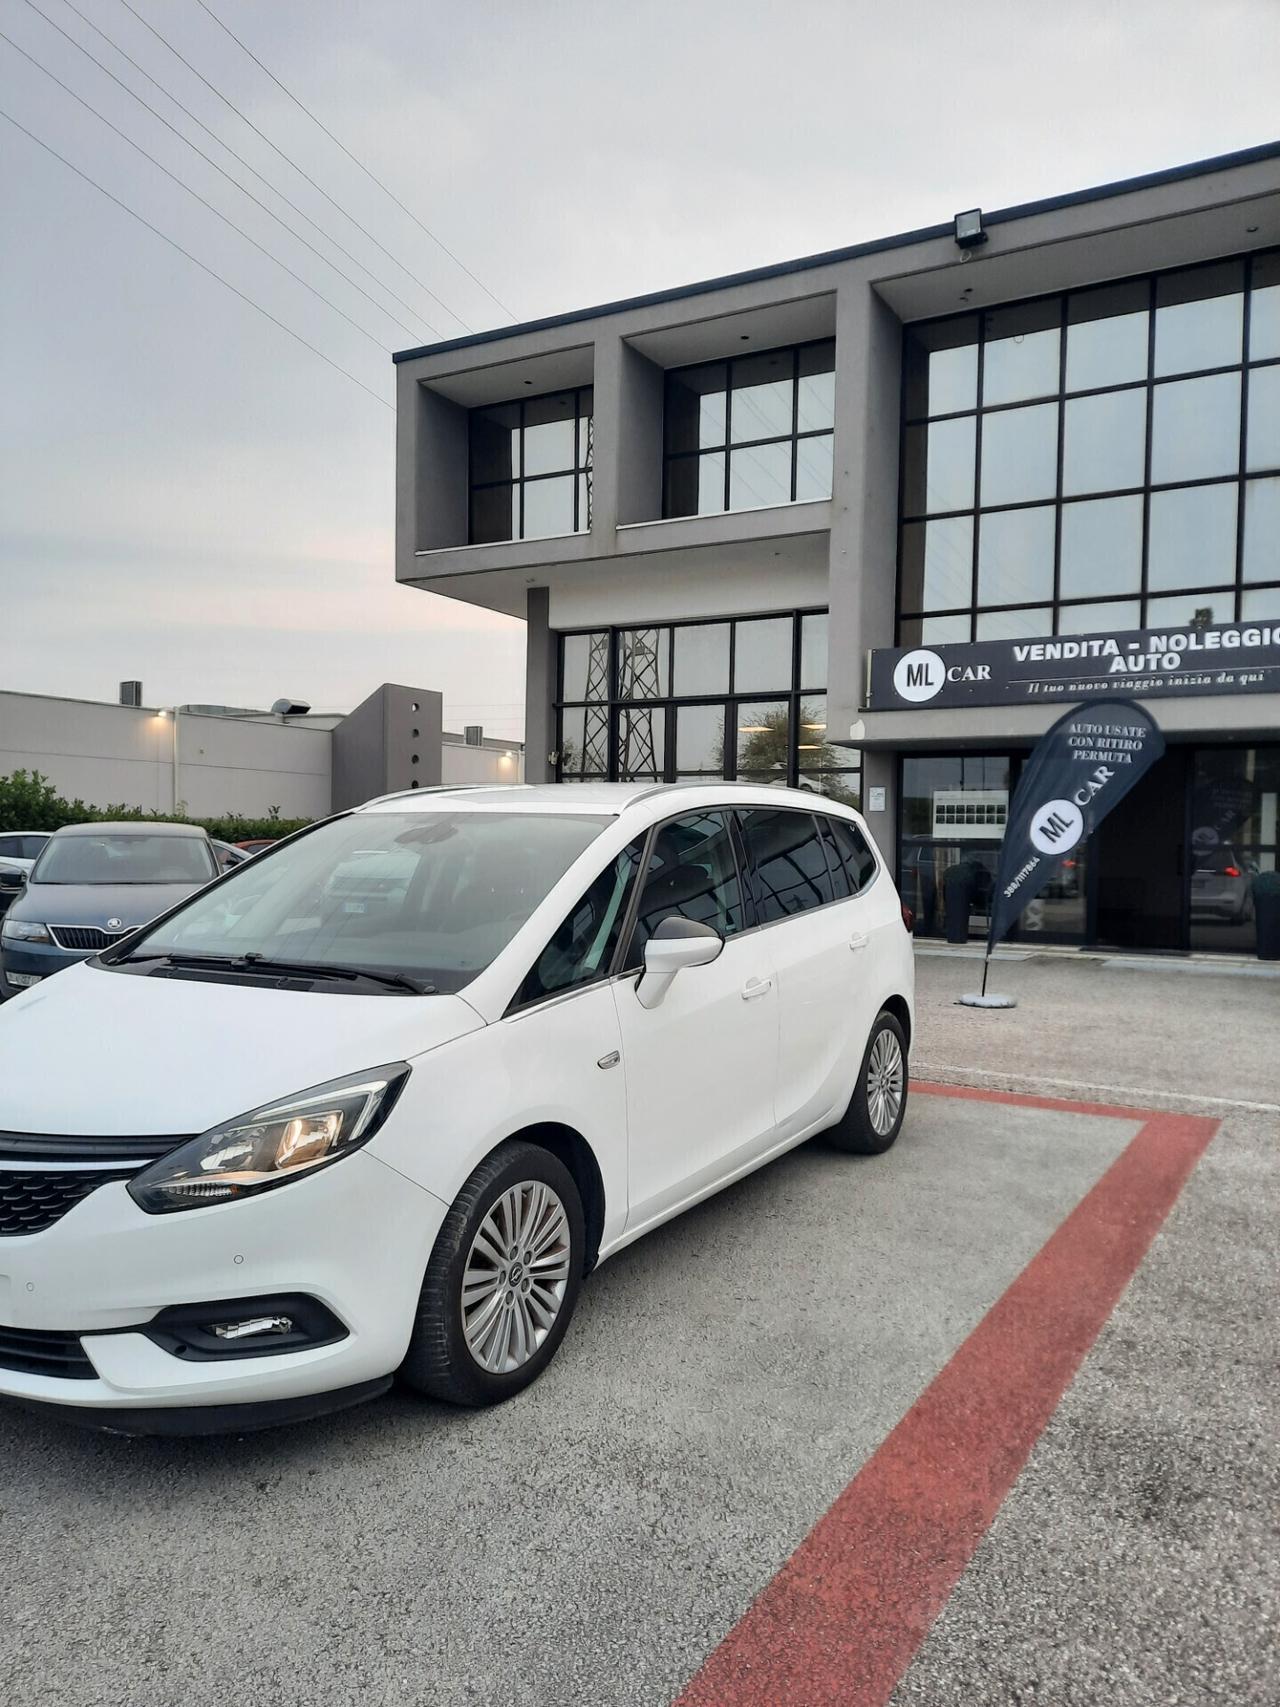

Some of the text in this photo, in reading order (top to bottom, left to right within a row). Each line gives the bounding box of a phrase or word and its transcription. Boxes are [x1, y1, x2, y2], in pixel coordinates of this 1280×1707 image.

[1013, 639, 1120, 662] VENDITA
[1109, 652, 1181, 674] AUTO
[906, 663, 992, 687] ML CAR
[1028, 670, 1265, 693] Il tuo nuovo viaggio inizia da qui
[1068, 723, 1147, 738] AUTO USATE
[1068, 736, 1143, 750] CON RITIRO
[1073, 750, 1132, 763] PERMUTA
[1039, 765, 1115, 843] ML CAR
